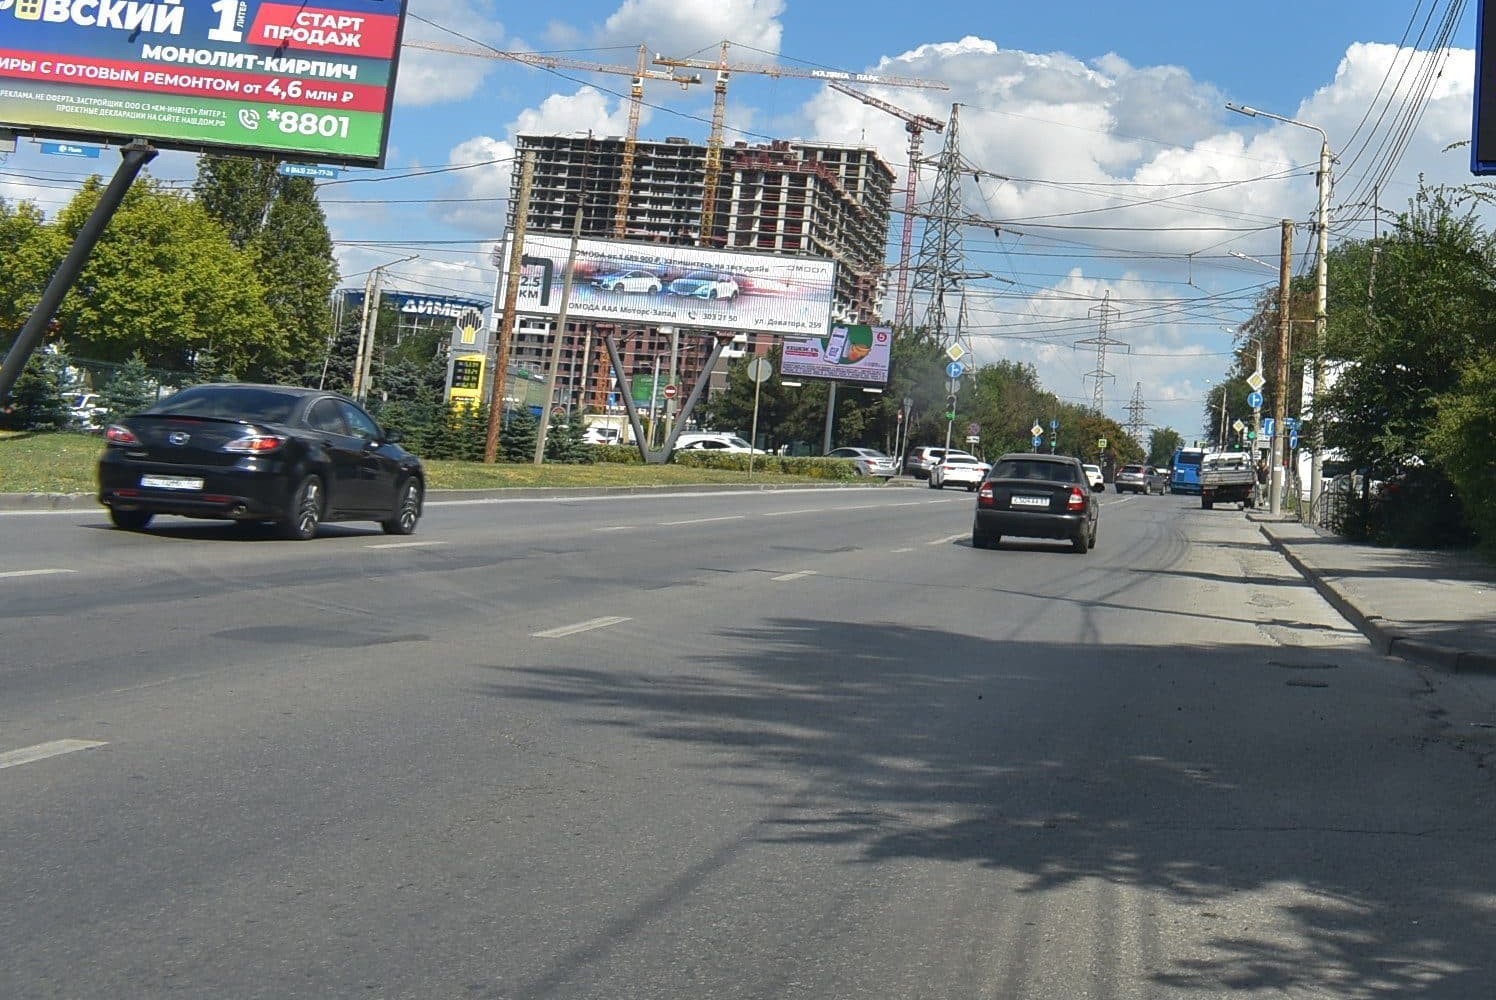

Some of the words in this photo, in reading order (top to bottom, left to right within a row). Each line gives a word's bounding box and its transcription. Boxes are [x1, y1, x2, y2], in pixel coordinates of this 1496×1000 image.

[237, 1, 247, 28] ЛИТЕР
[296, 12, 365, 32] СТАРТ
[263, 25, 362, 47] ПРОДАЖ
[141, 44, 358, 80] МОНОЛИТ-КИРПИЧ
[40, 61, 52, 74] С
[55, 63, 139, 83] ГОТОВЫМ
[143, 71, 239, 92] РЕМОНТОМ
[243, 84, 262, 94] от
[265, 79, 303, 100] 4,6
[56, 105, 98, 115] ПРОЕКТНЫЕ
[99, 108, 146, 120] ДЕКЛАРАЦИИ
[157, 113, 180, 123] САЙТЕ
[519, 289, 539, 298] КМ
